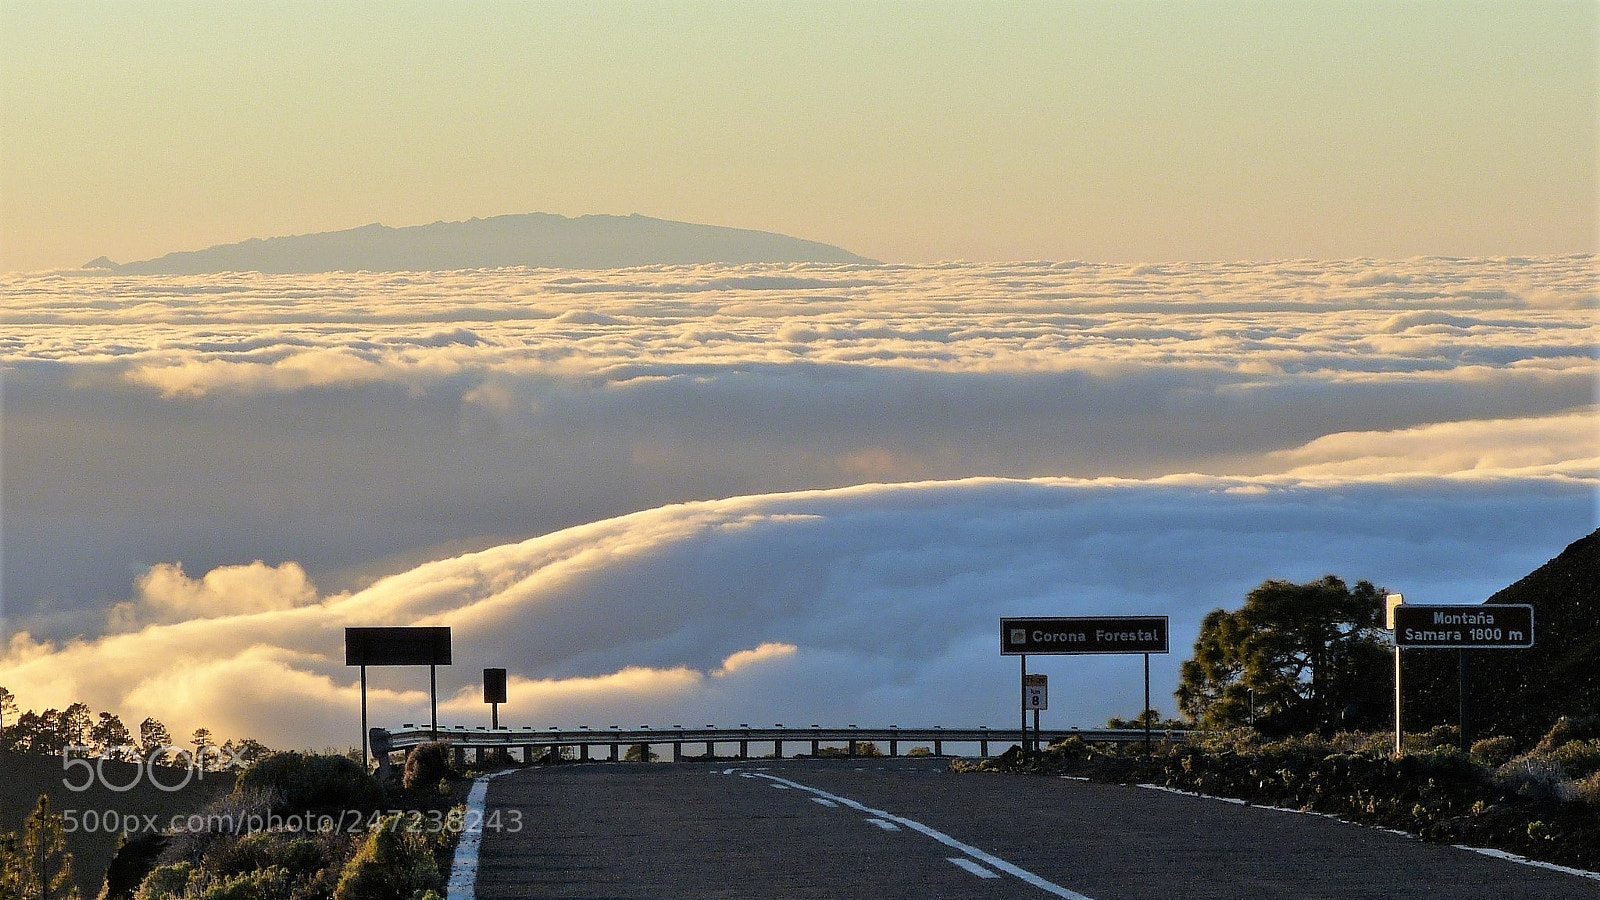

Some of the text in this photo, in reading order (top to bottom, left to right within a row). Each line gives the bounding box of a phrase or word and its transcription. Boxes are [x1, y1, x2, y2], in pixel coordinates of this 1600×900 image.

[1434, 611, 1494, 625] Montaña
[1032, 629, 1159, 642] Corona Forestal
[1405, 628, 1523, 641] Samara 1800 m
[1032, 696, 1040, 705] 8
